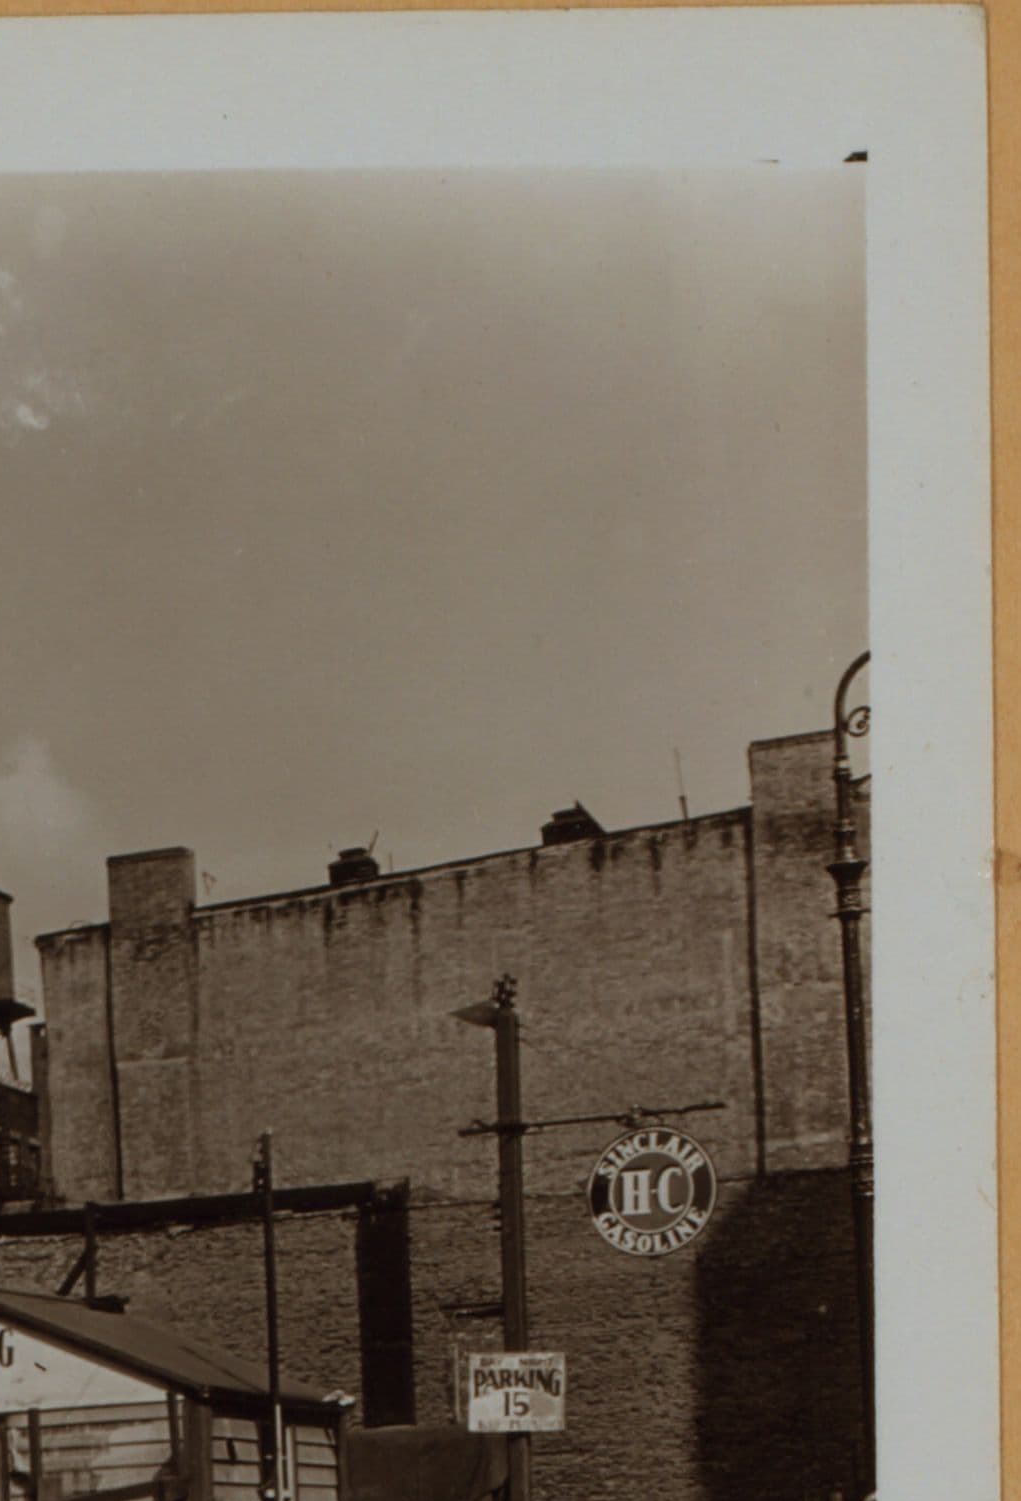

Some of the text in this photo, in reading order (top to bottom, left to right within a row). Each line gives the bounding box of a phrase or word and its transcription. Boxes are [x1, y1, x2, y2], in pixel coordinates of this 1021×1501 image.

[597, 1131, 705, 1179] SINCLAIR
[620, 1166, 684, 1215] H-C
[597, 1205, 708, 1253] GASOLINE
[473, 1367, 562, 1398] PARKING
[504, 1391, 530, 1417] 15
